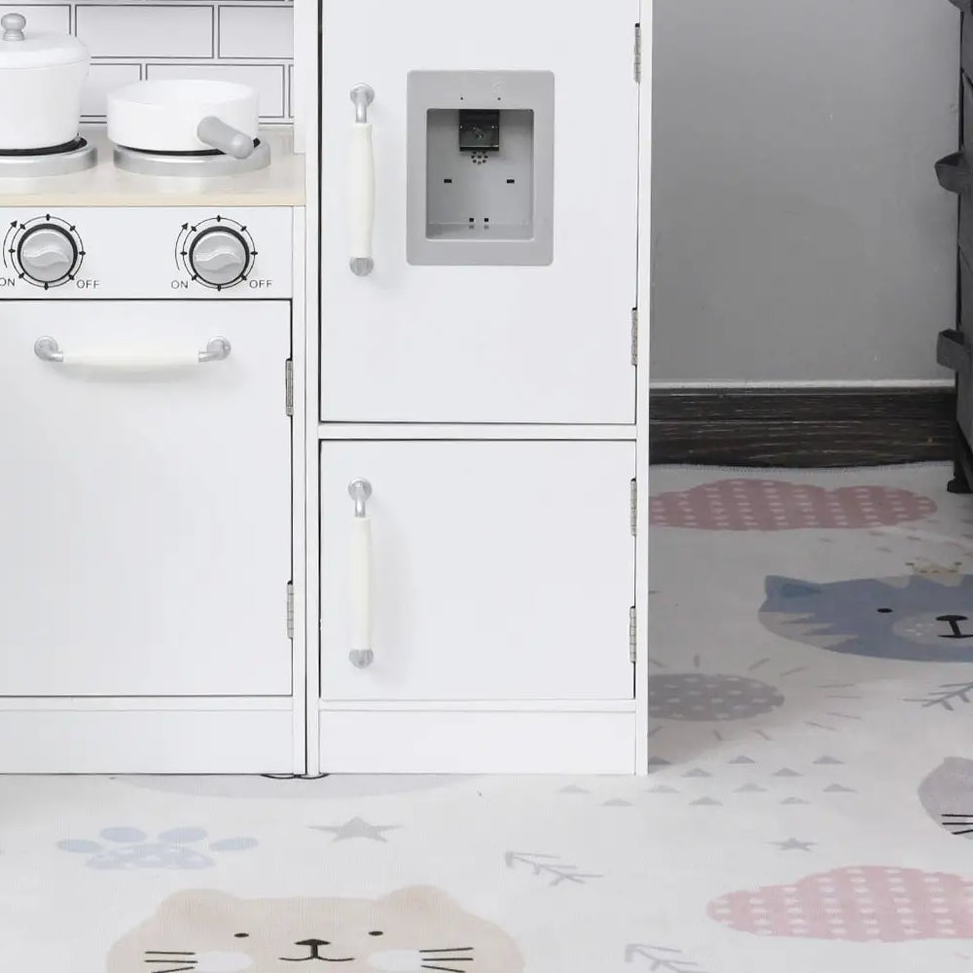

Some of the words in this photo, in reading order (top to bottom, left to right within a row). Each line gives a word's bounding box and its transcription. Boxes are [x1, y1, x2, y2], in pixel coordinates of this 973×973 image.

[76, 279, 100, 289] OFF
[171, 280, 189, 290] ON
[249, 279, 273, 289] OFF
